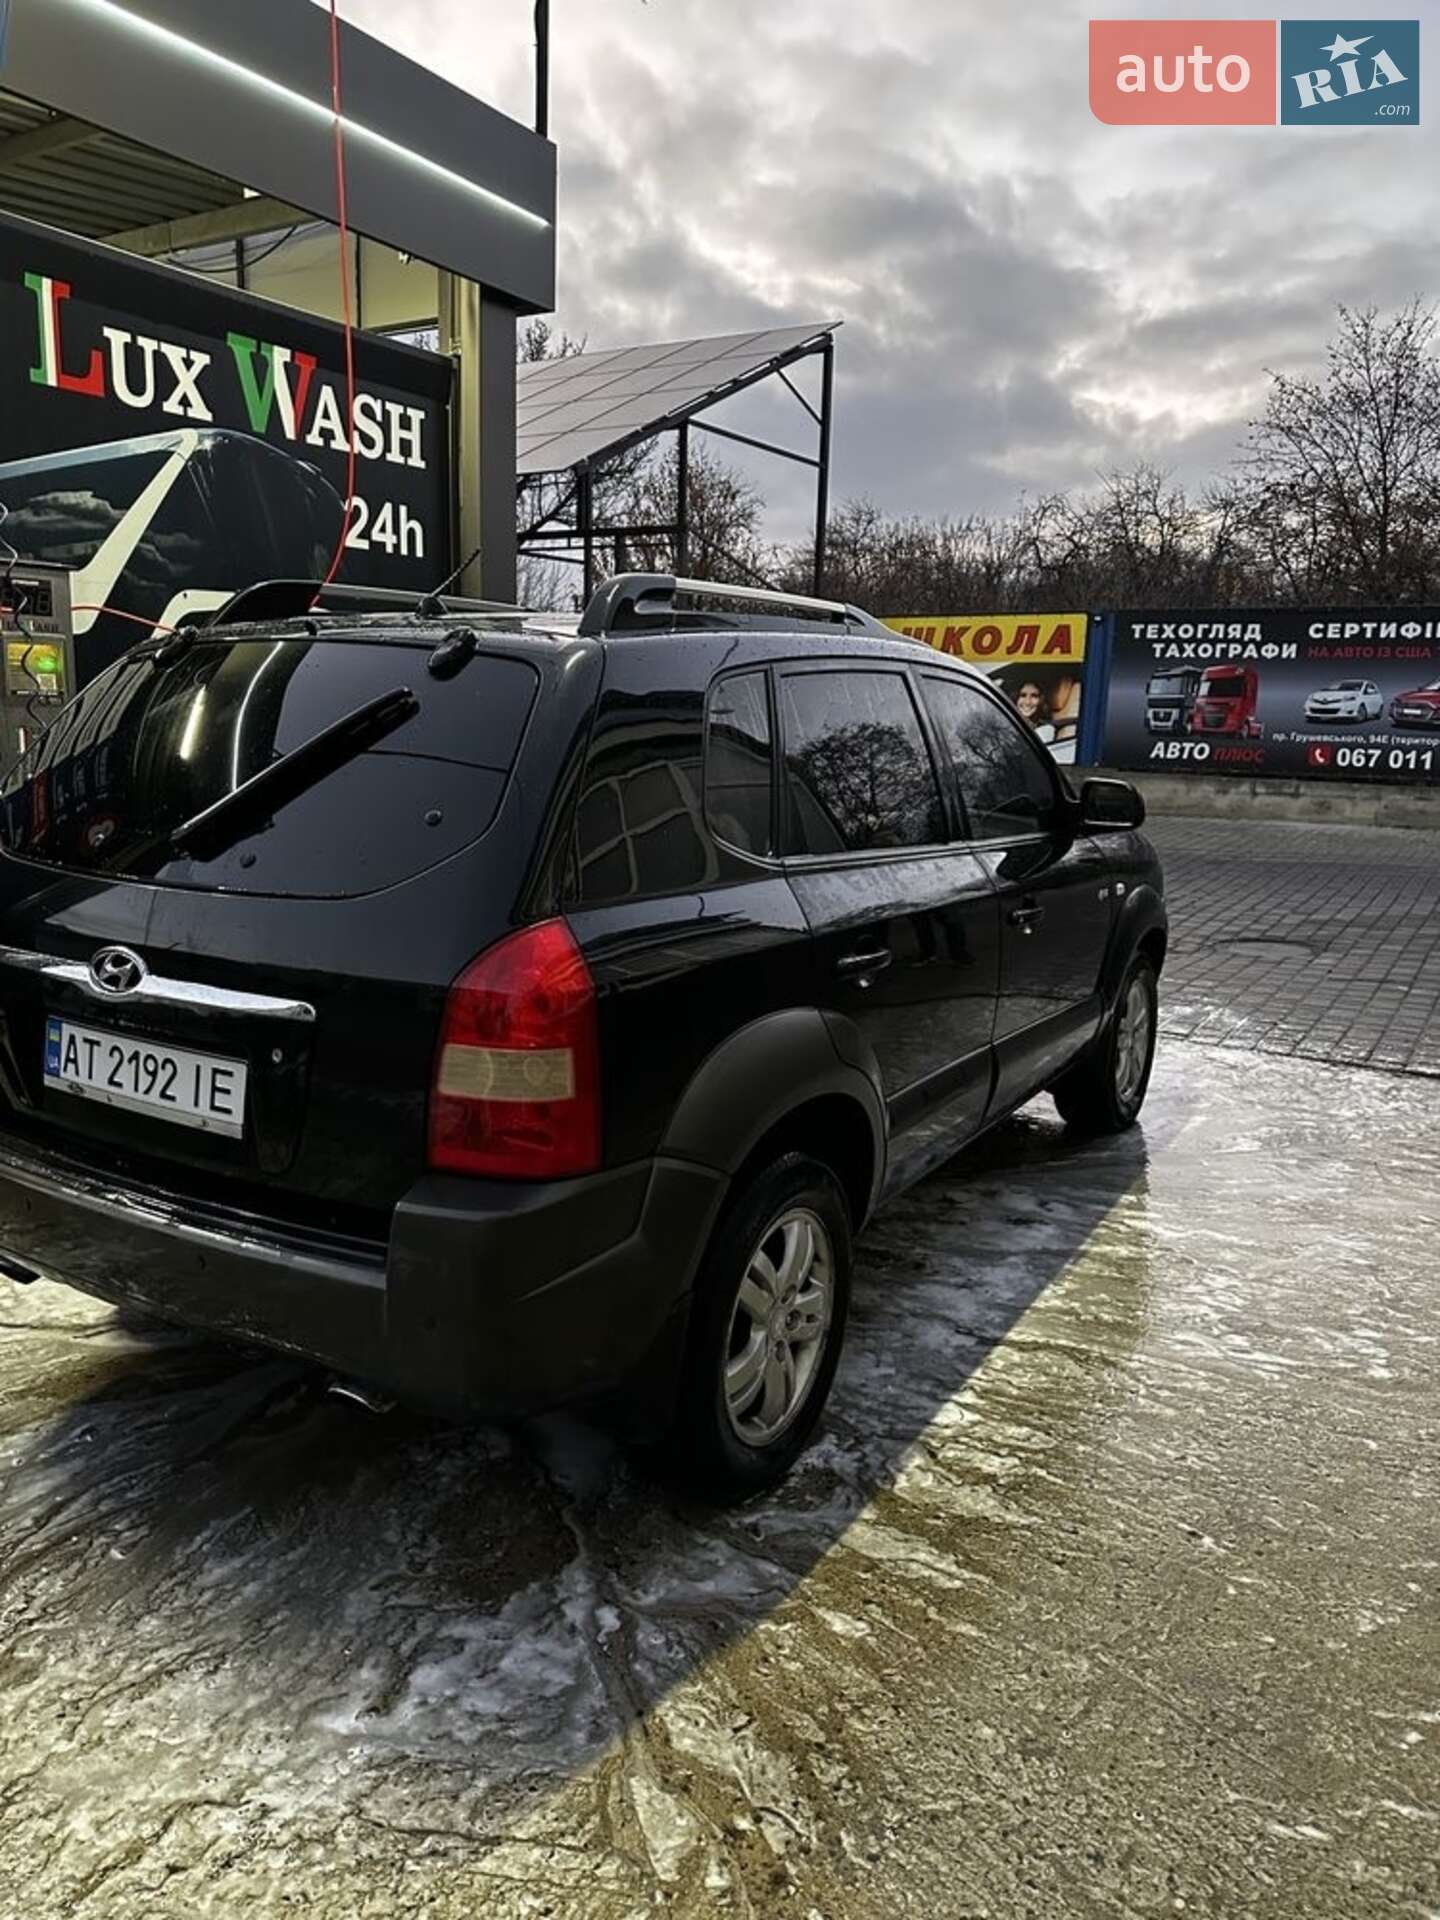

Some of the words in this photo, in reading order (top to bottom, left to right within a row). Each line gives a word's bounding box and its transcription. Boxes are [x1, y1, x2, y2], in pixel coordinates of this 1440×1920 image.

[227, 331, 426, 469] WASH
[344, 496, 424, 558] 24h
[1131, 623, 1262, 642] ТЕХОГЛЯД
[1152, 642, 1298, 659] ТАХОГРАФИ
[1308, 646, 1332, 657] НА
[1333, 646, 1374, 657] АВТО
[1377, 646, 1392, 657] ІЗ
[1395, 646, 1432, 658] США
[1149, 740, 1211, 760] АВТО
[1336, 748, 1382, 767] 067
[1388, 750, 1433, 770] 011
[62, 1033, 102, 1080] AT
[107, 1045, 178, 1102] 2192
[193, 1063, 235, 1115] IE
